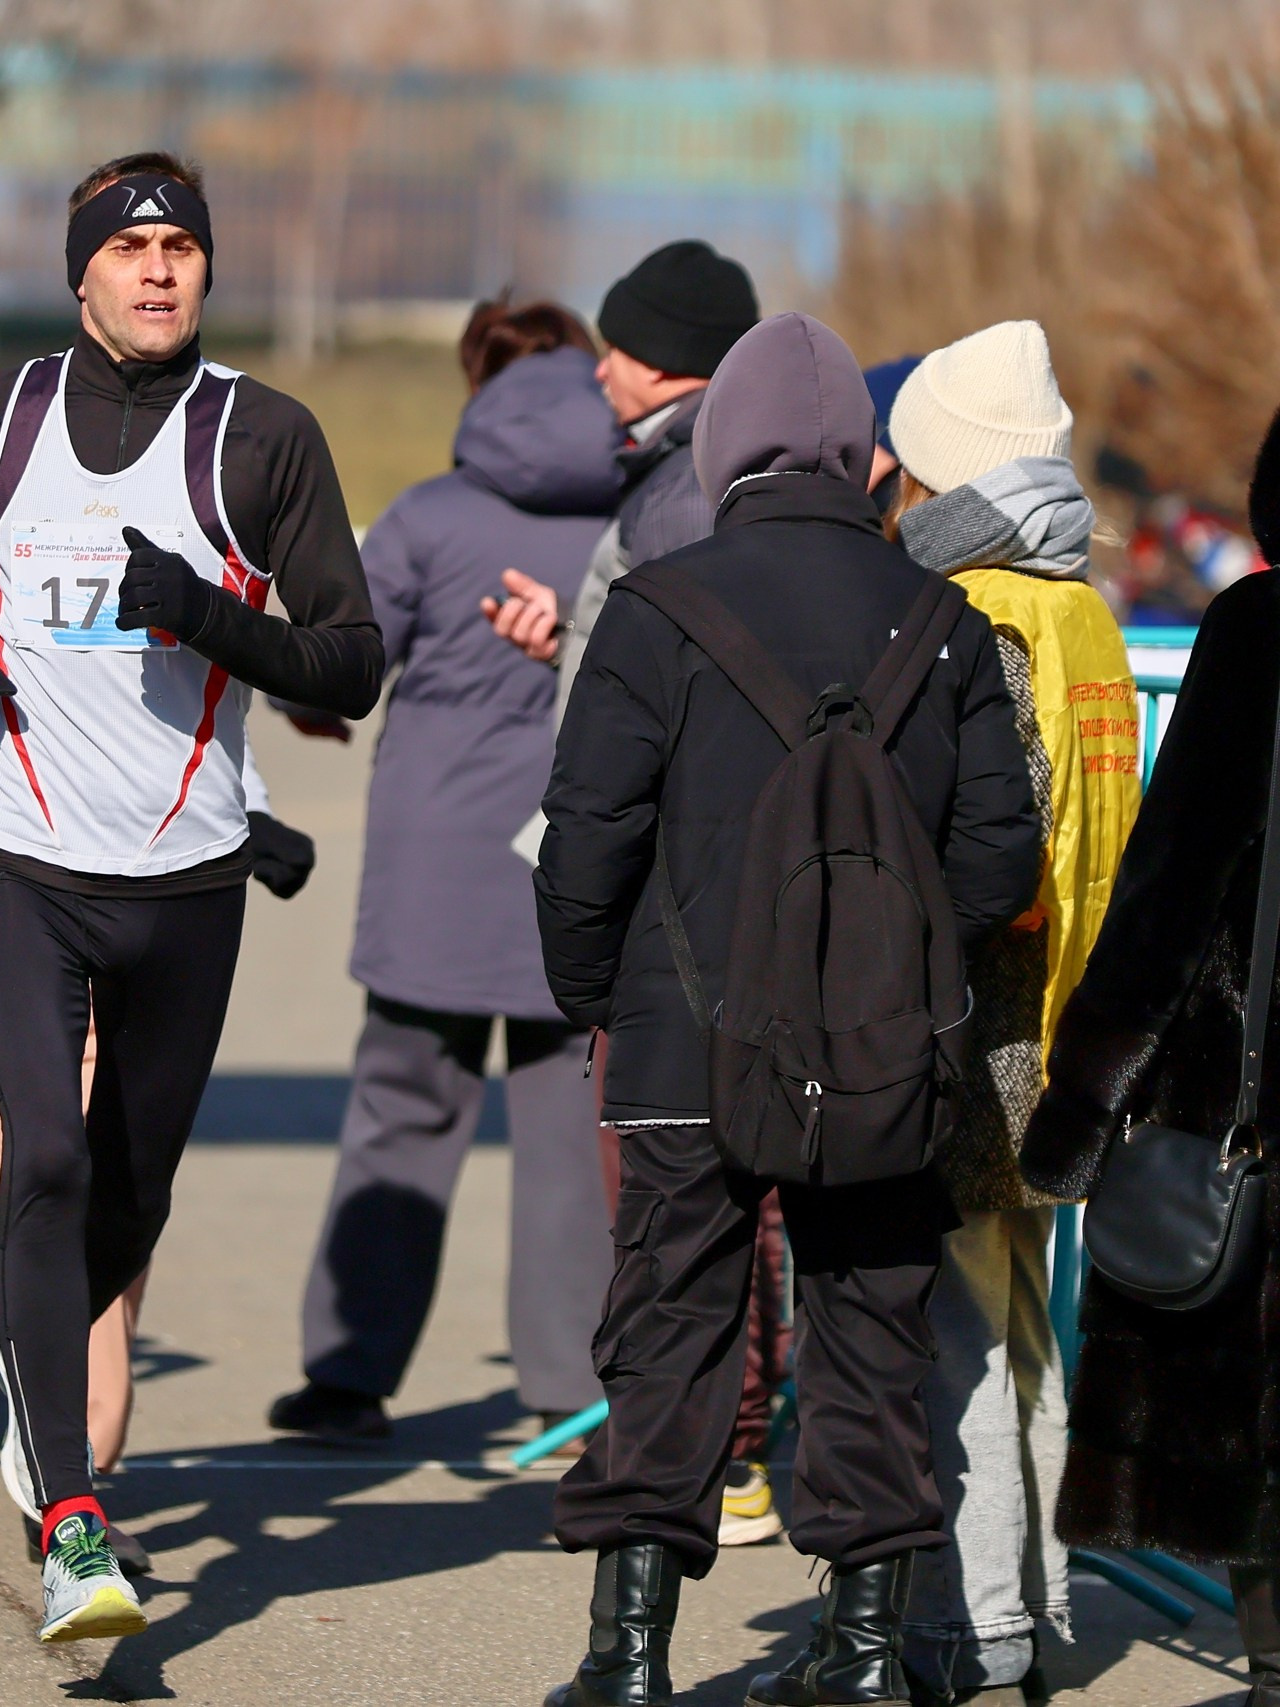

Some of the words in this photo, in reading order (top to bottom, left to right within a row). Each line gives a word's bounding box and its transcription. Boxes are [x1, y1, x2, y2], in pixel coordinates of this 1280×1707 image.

[132, 209, 164, 218] adidas
[14, 543, 32, 558] 55
[35, 544, 113, 553] МЕЖРЕГИОНАЛЬНЫЙ
